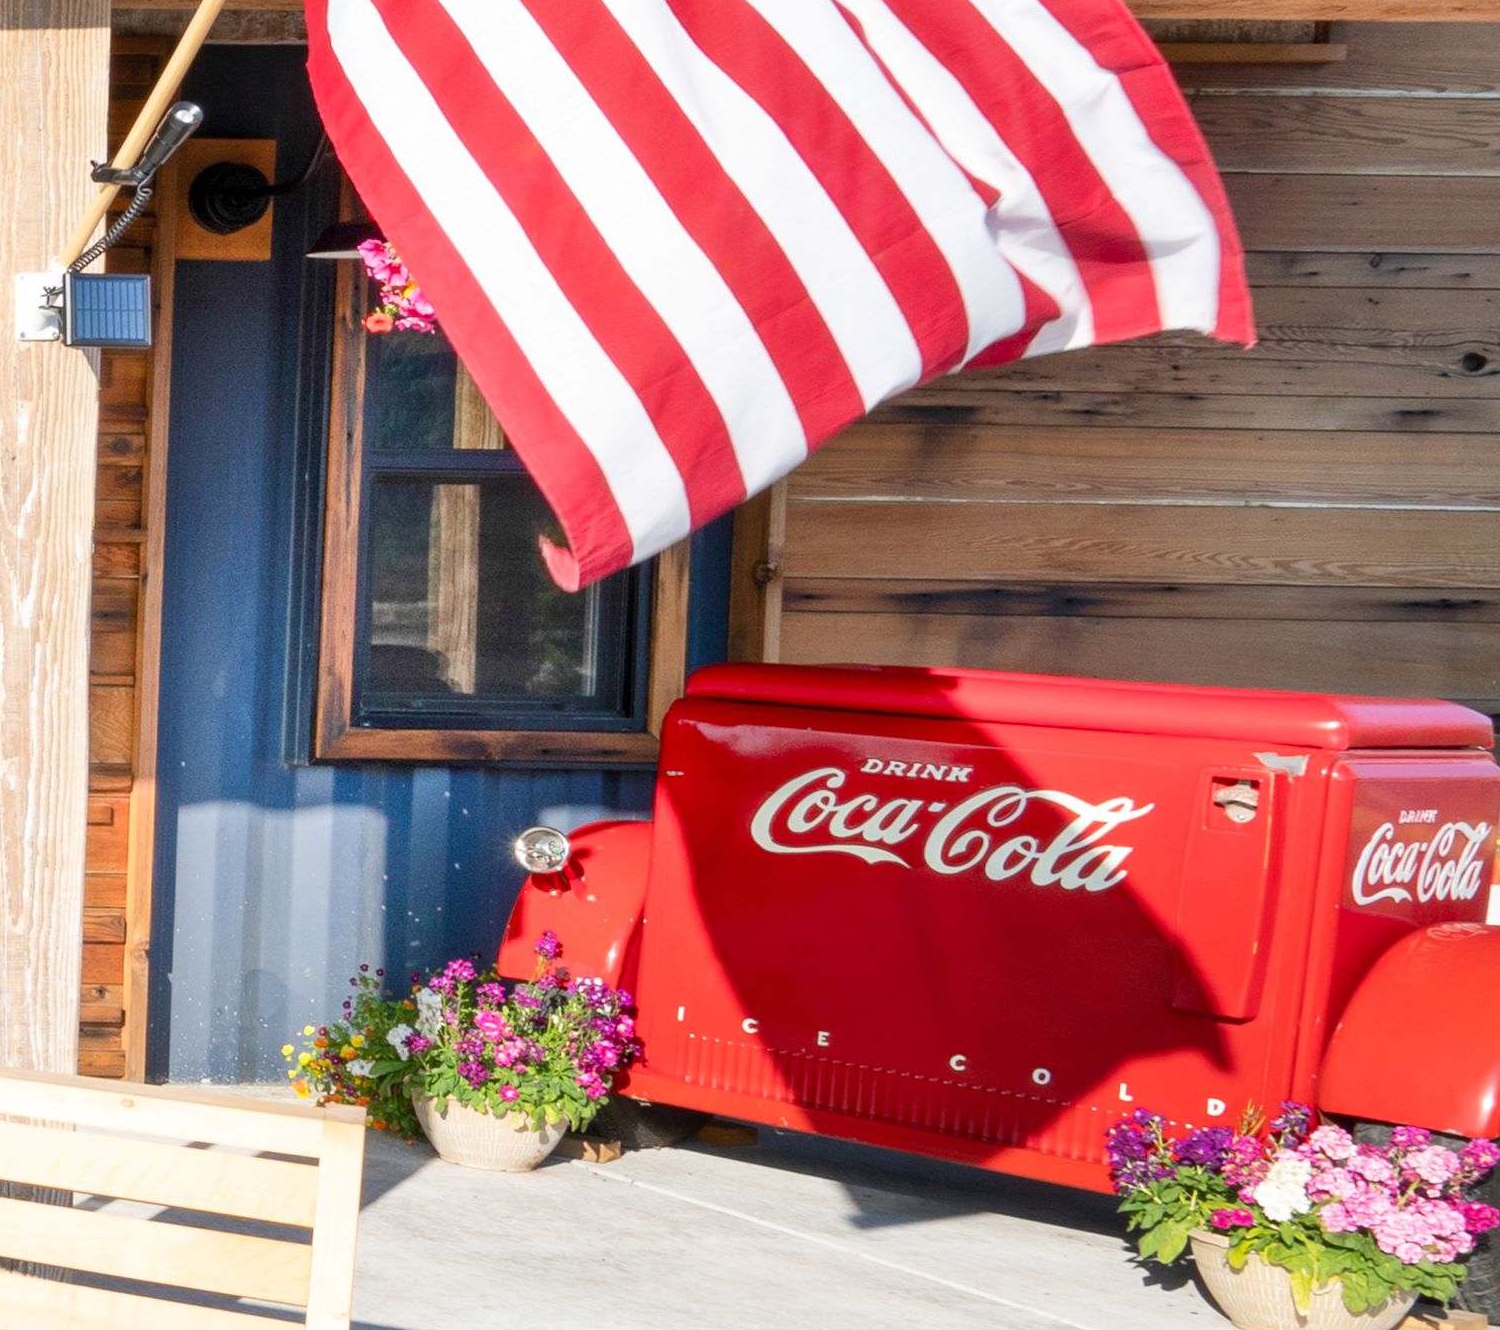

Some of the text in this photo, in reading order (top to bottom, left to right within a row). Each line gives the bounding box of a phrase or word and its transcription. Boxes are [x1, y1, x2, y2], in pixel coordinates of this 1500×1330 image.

[860, 758, 974, 782] DRINK
[750, 767, 1155, 893] Coca-Cola
[1398, 809, 1438, 823] DRINK
[1352, 821, 1492, 903] Coca-Cola
